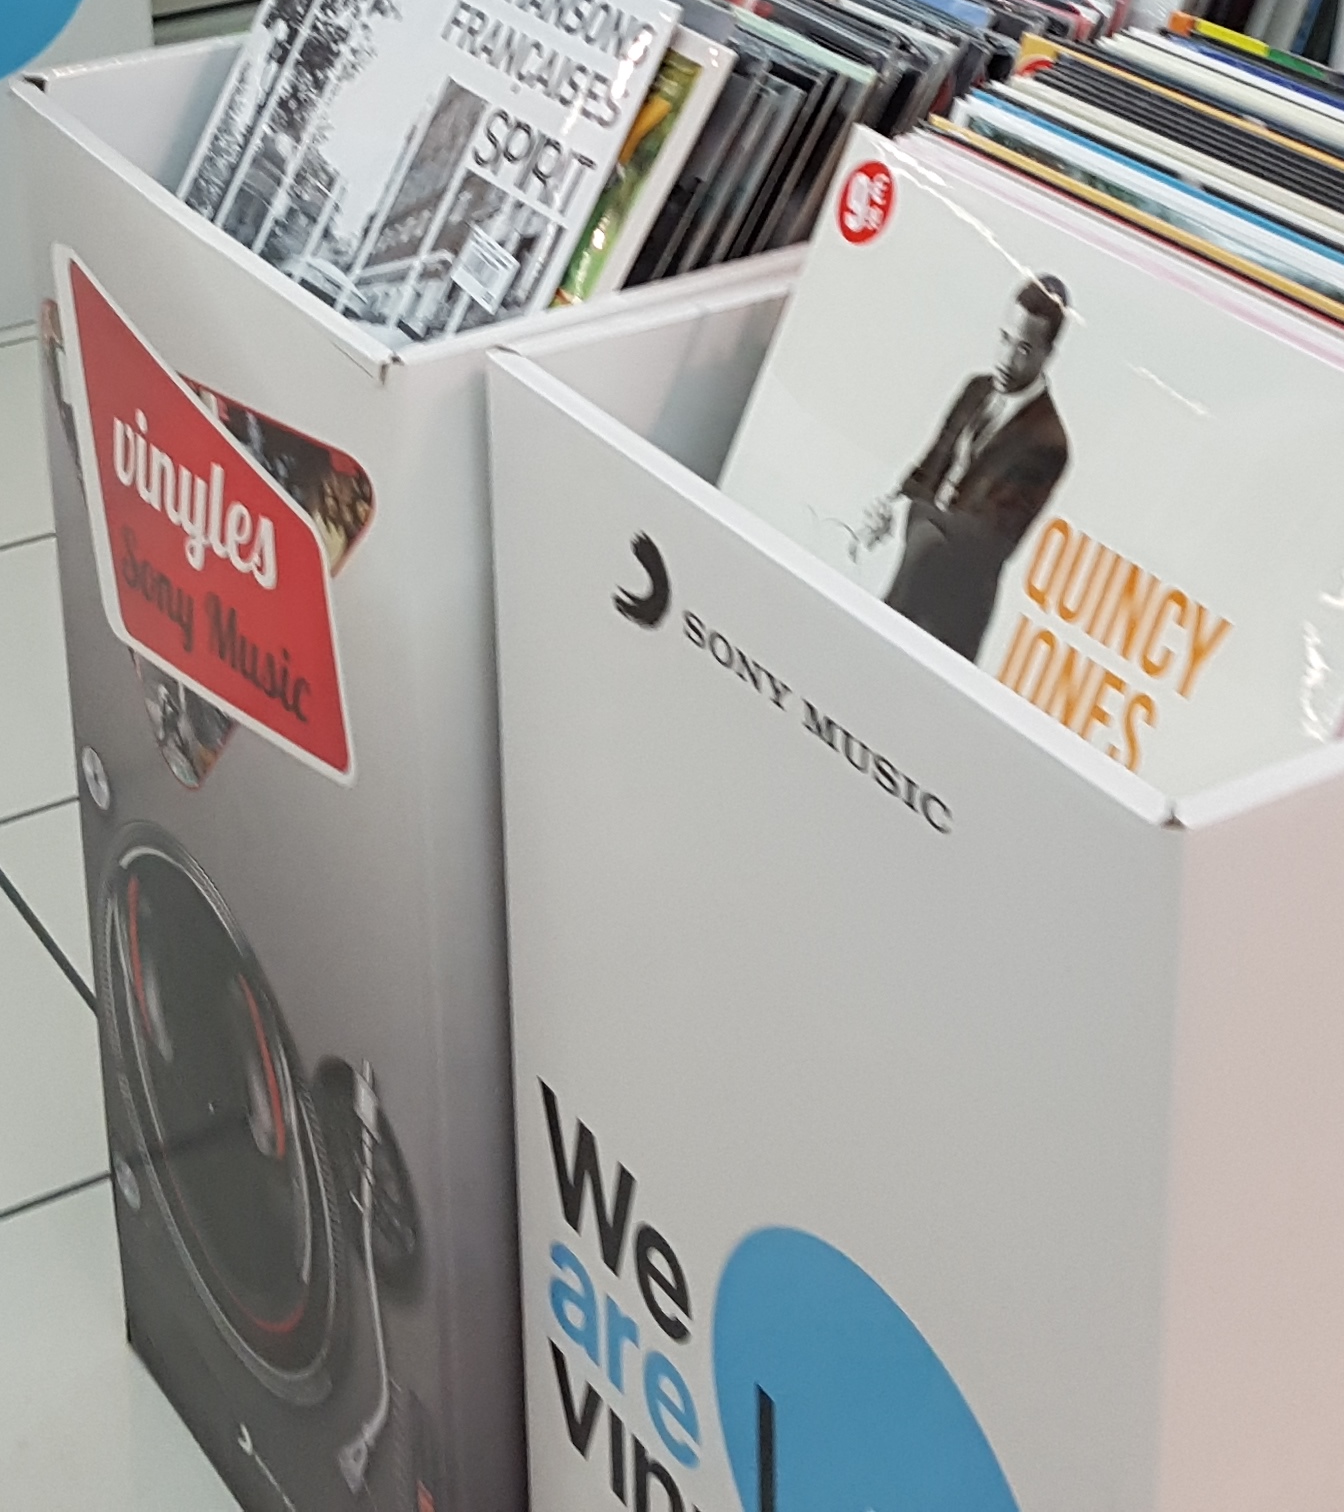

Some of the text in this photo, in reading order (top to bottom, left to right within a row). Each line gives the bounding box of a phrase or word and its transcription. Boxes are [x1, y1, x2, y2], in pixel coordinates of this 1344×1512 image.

[470, 108, 597, 220] SPIRIT
[112, 408, 278, 591] vinyles
[121, 524, 312, 725] Sony Music
[1022, 517, 1234, 700] QUINCY
[681, 607, 954, 835] SONY MUSIC
[537, 1075, 693, 1345] We
[548, 1240, 700, 1469] are
